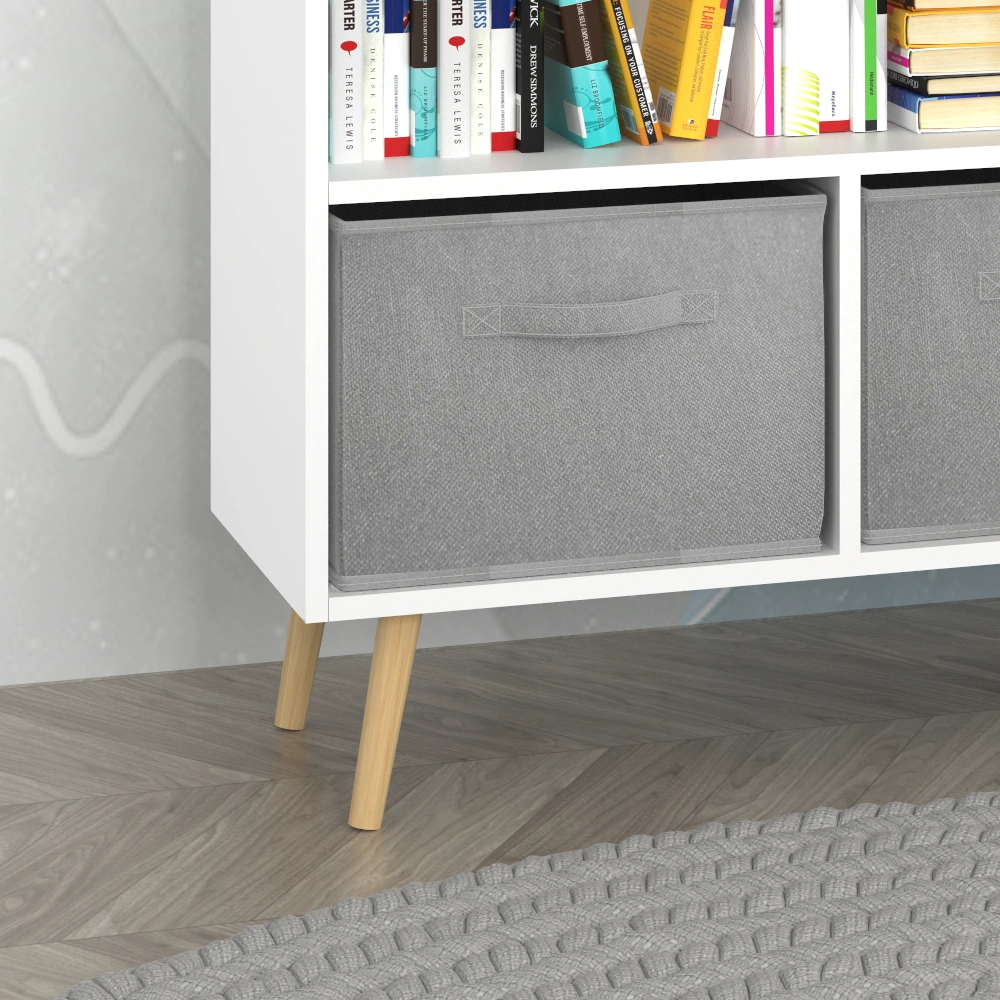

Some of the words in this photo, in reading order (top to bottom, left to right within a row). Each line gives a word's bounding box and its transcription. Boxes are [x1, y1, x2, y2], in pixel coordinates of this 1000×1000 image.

[614, 6, 630, 43] FOCUSING
[700, 5, 716, 30] FLAIR
[579, 15, 593, 61] SELF-EMPLOYMENT
[624, 45, 633, 56] ON
[529, 45, 538, 76] DREW
[626, 57, 639, 77] YOUR
[345, 67, 354, 109] TERESA
[453, 62, 462, 104] TERESA
[590, 79, 598, 88] LIZ
[632, 78, 649, 117] CUSTOMER
[529, 77, 538, 128] SIMMONS
[592, 90, 604, 129] BROOMFIELD
[345, 116, 354, 151] LEWIS
[453, 111, 462, 145] LEWIS
